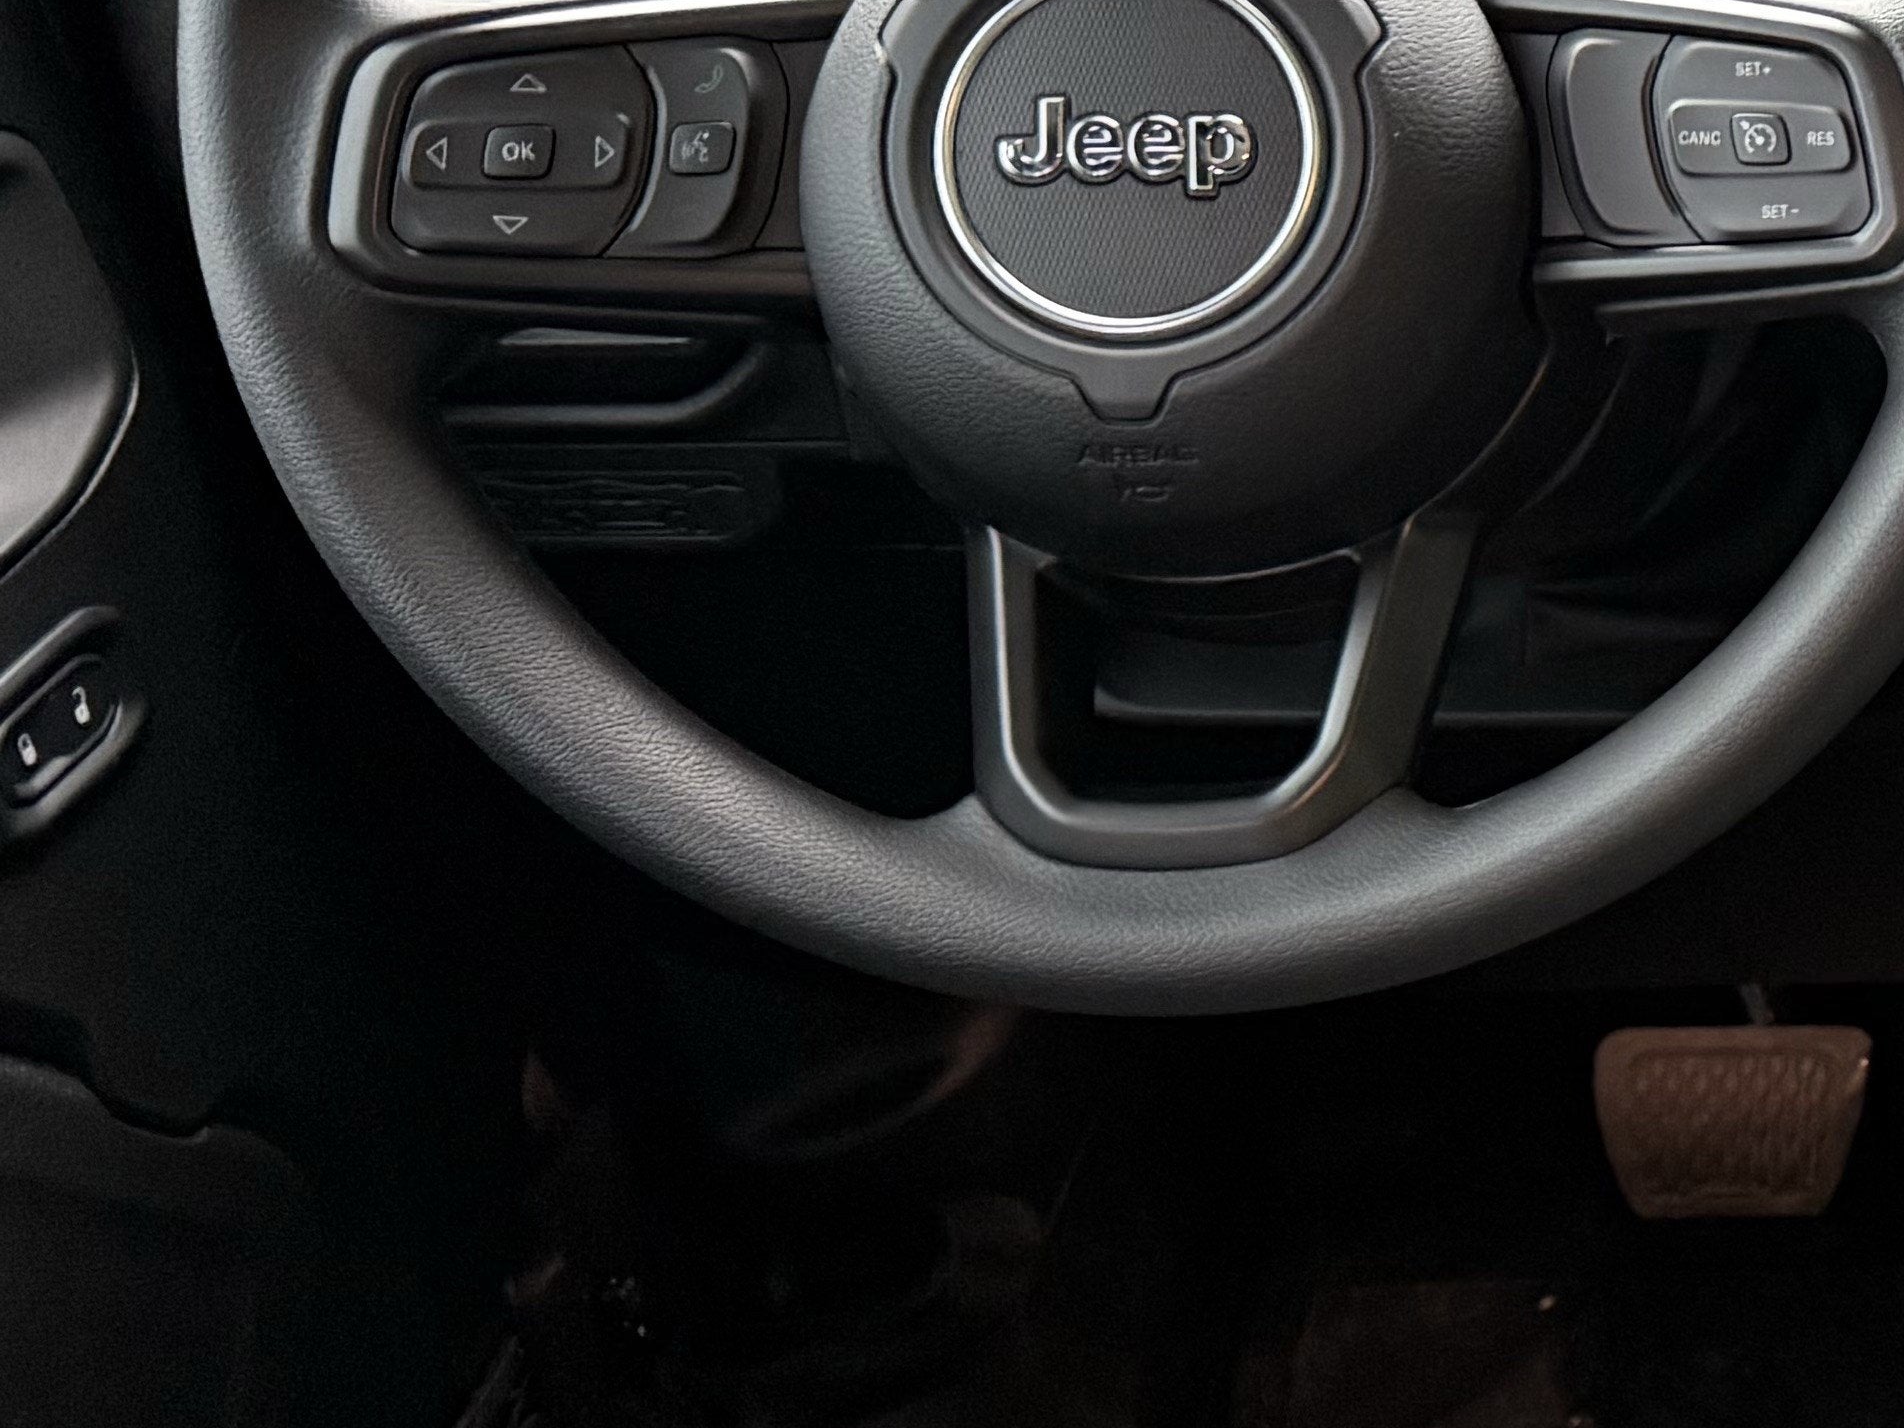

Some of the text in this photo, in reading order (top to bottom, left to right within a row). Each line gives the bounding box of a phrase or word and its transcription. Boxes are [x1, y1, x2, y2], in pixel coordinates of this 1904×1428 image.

[995, 94, 1257, 199] Jeep
[1678, 130, 1722, 147] CANC
[1806, 130, 1836, 147] RES
[501, 140, 536, 162] OK
